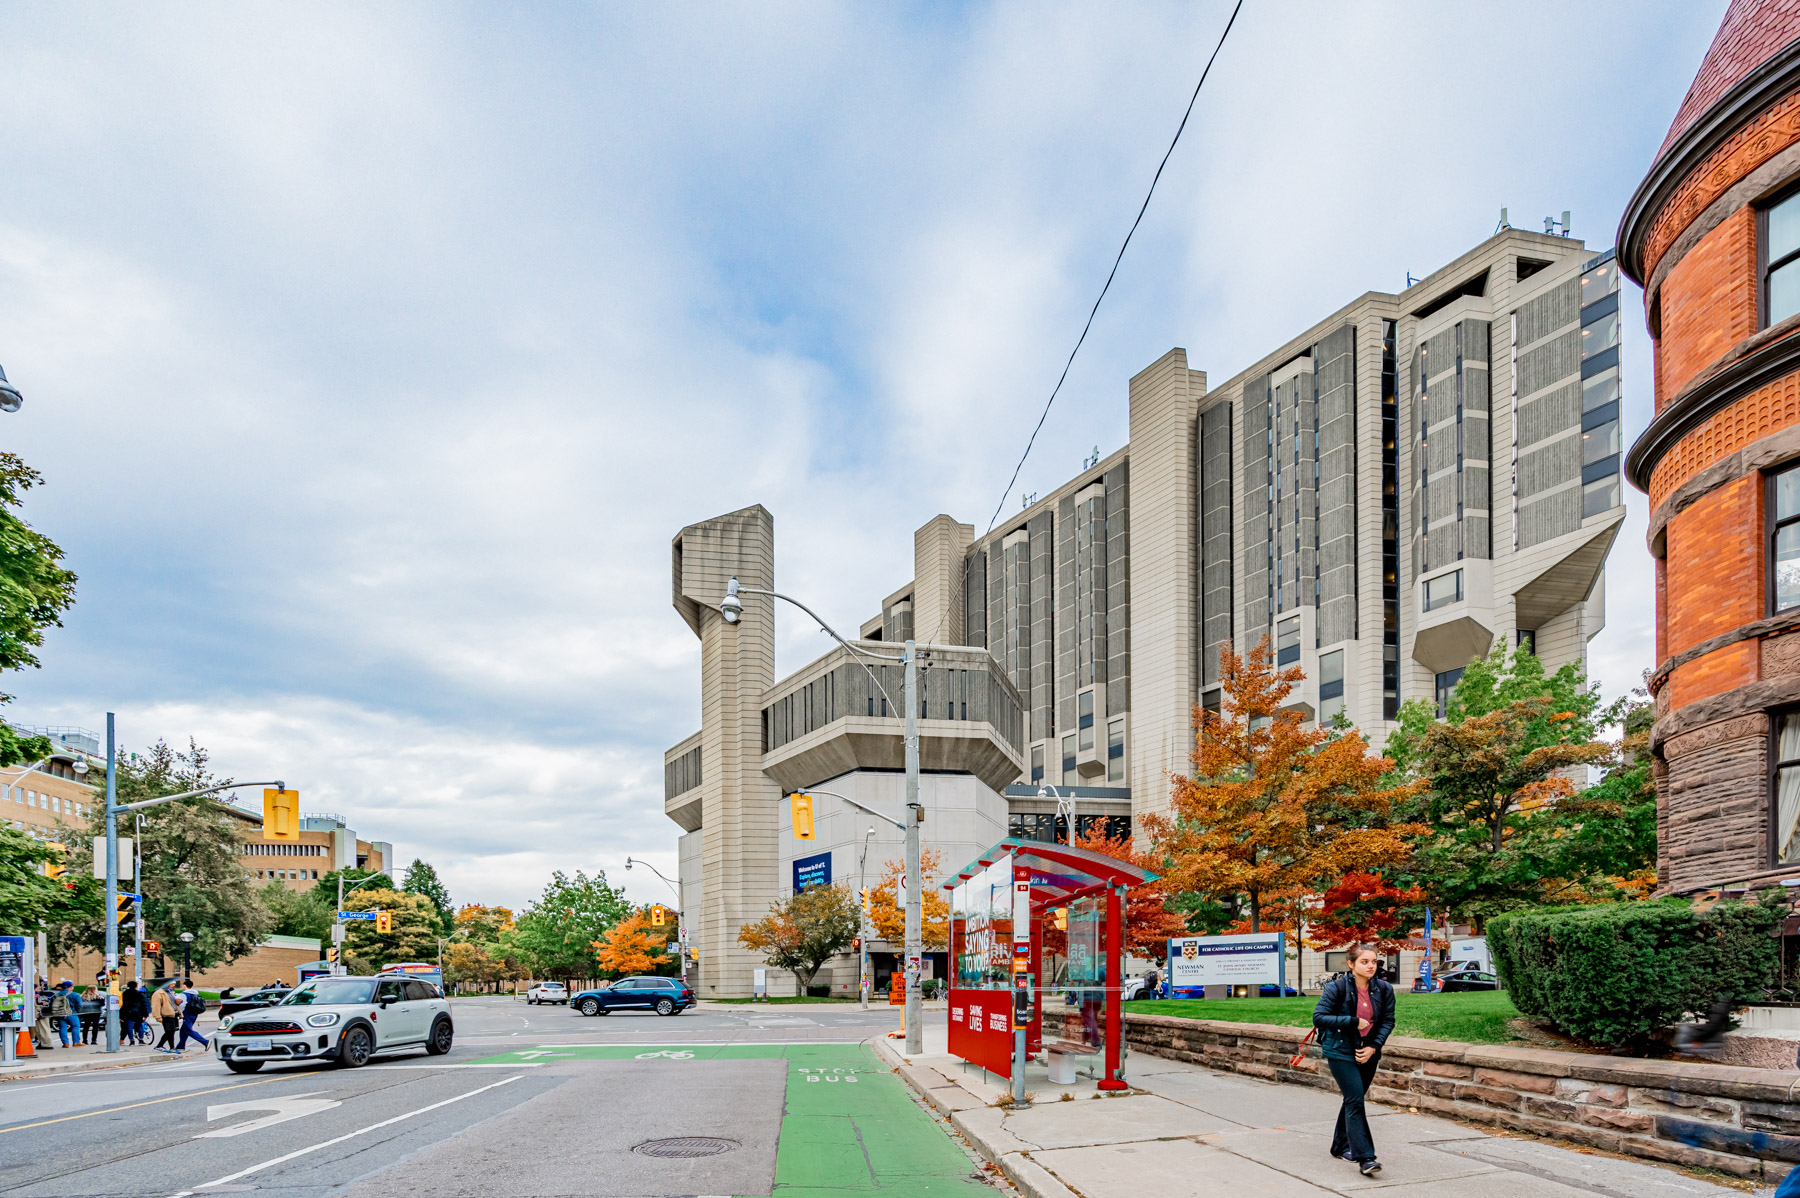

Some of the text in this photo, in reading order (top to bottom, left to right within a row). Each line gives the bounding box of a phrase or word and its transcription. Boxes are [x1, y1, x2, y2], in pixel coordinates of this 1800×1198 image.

[965, 929, 989, 955] SAYING
[965, 956, 973, 973] TO
[970, 1004, 982, 1016] SAVING
[969, 1016, 982, 1032] LIVES
[990, 1019, 1007, 1032] BUSINESS
